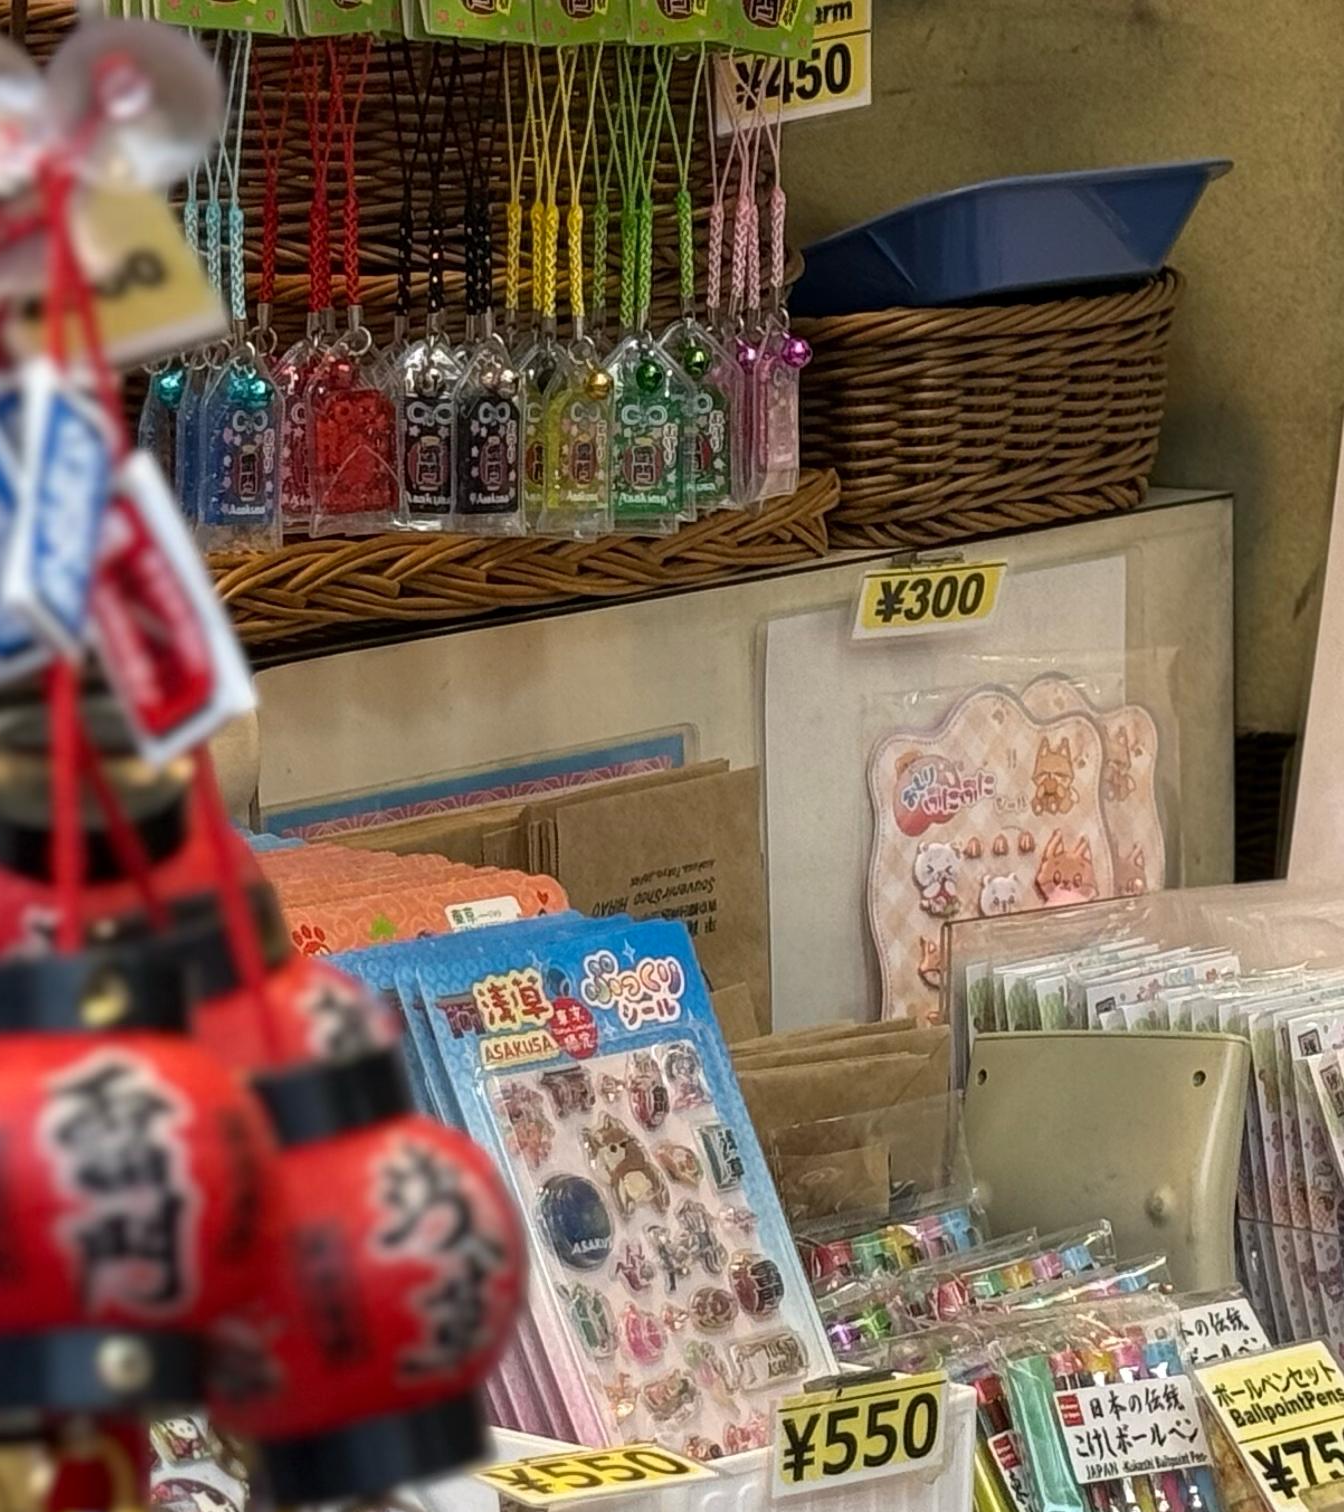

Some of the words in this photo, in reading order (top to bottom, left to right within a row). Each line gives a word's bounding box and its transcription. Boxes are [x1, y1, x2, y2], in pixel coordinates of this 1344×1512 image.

[811, 1, 854, 24] arm
[874, 573, 985, 625] ¥300
[474, 970, 553, 1030] 浅草
[582, 951, 685, 1009] ぷっくり
[619, 998, 681, 1030] シール
[483, 1034, 555, 1063] ASAKUSA
[1088, 1383, 1185, 1420] 日本の伝統
[1212, 1359, 1337, 1407] ボールペンセット
[781, 1391, 941, 1482] ¥550
[1075, 1419, 1202, 1462] こけしボールペン
[496, 1449, 686, 1497] ¥550
